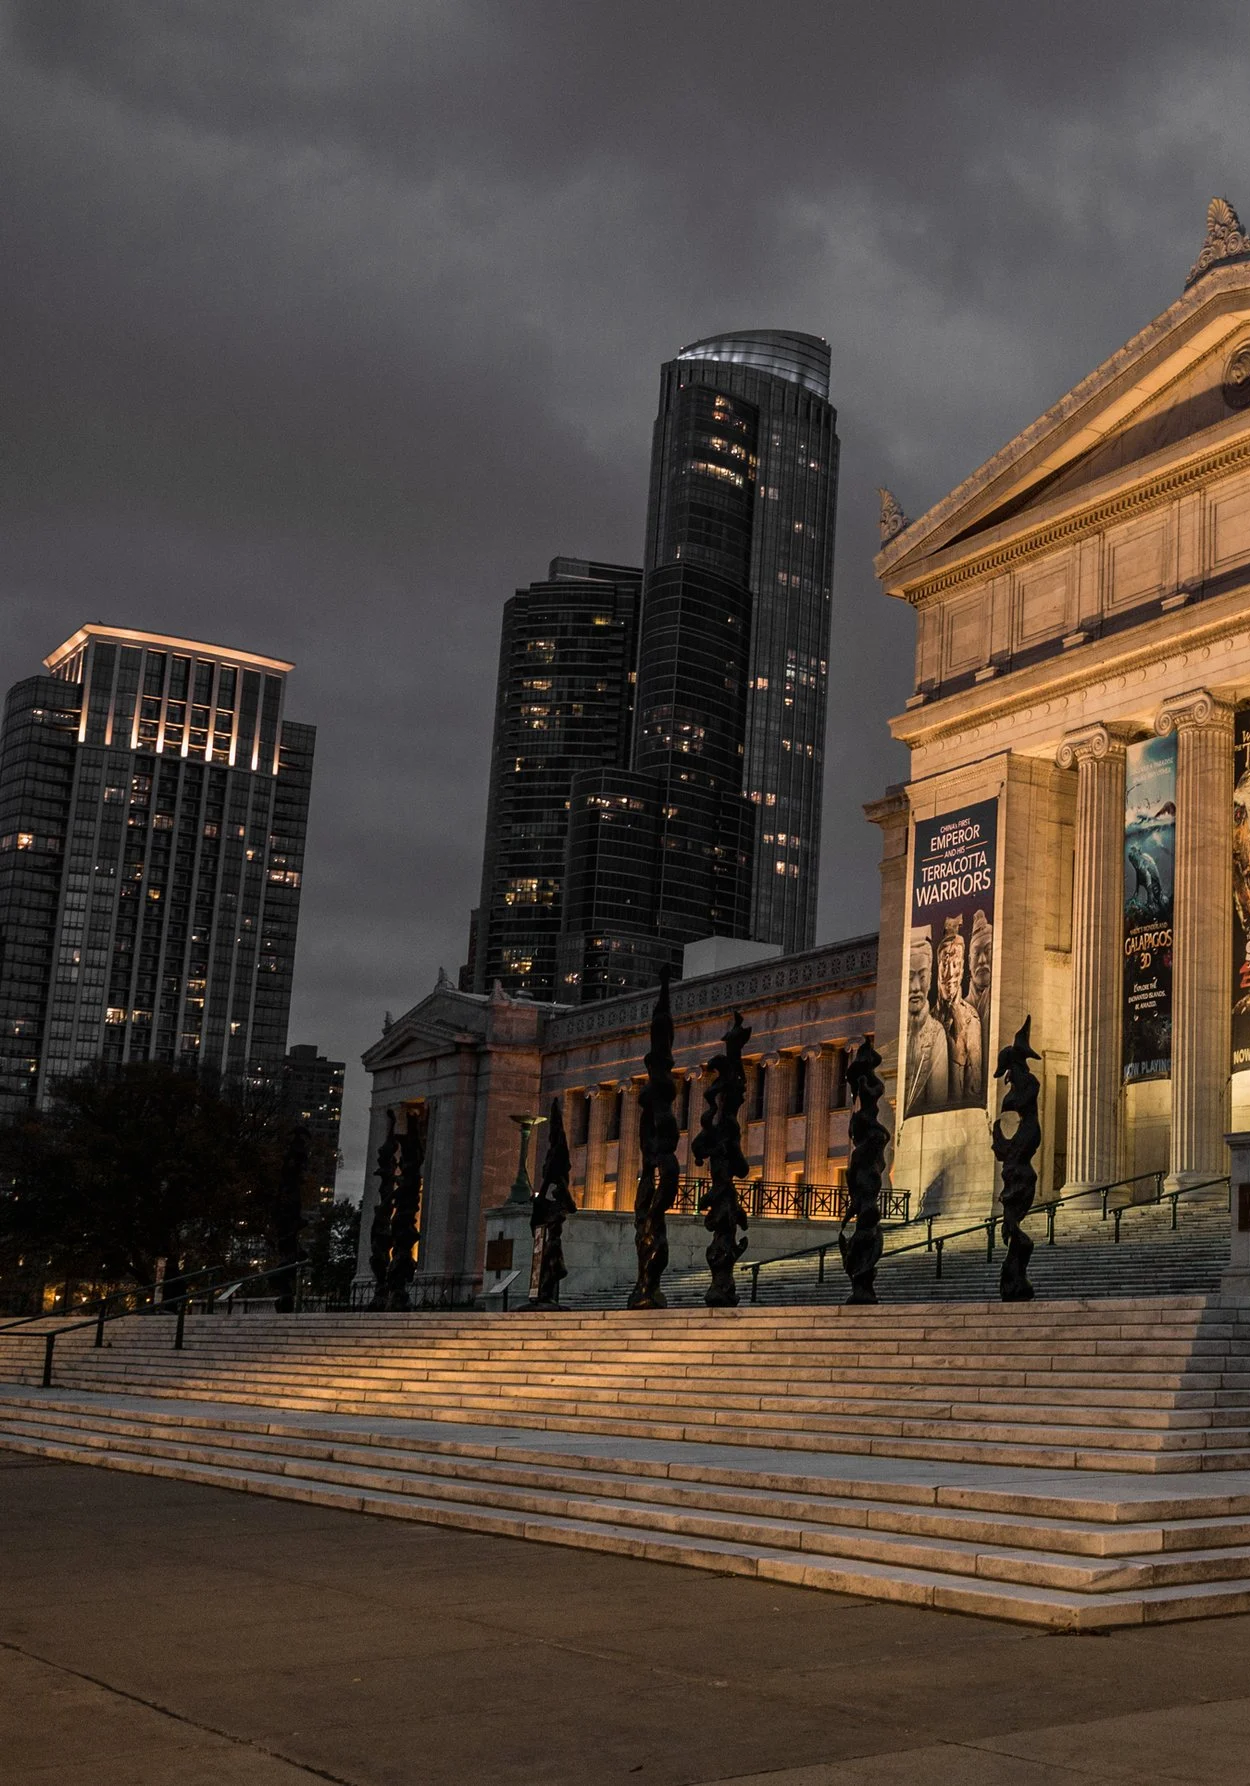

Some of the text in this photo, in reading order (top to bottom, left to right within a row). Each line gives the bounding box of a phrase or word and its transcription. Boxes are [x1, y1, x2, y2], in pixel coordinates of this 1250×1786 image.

[958, 818, 971, 828] FIRST
[930, 824, 980, 852] EMPEROR
[944, 845, 966, 858] AND HIS
[921, 850, 988, 883] TERRACOTTA
[916, 868, 991, 908] WARRIORS
[1124, 929, 1172, 956] GALAPAGOS
[1140, 952, 1152, 970] 3D
